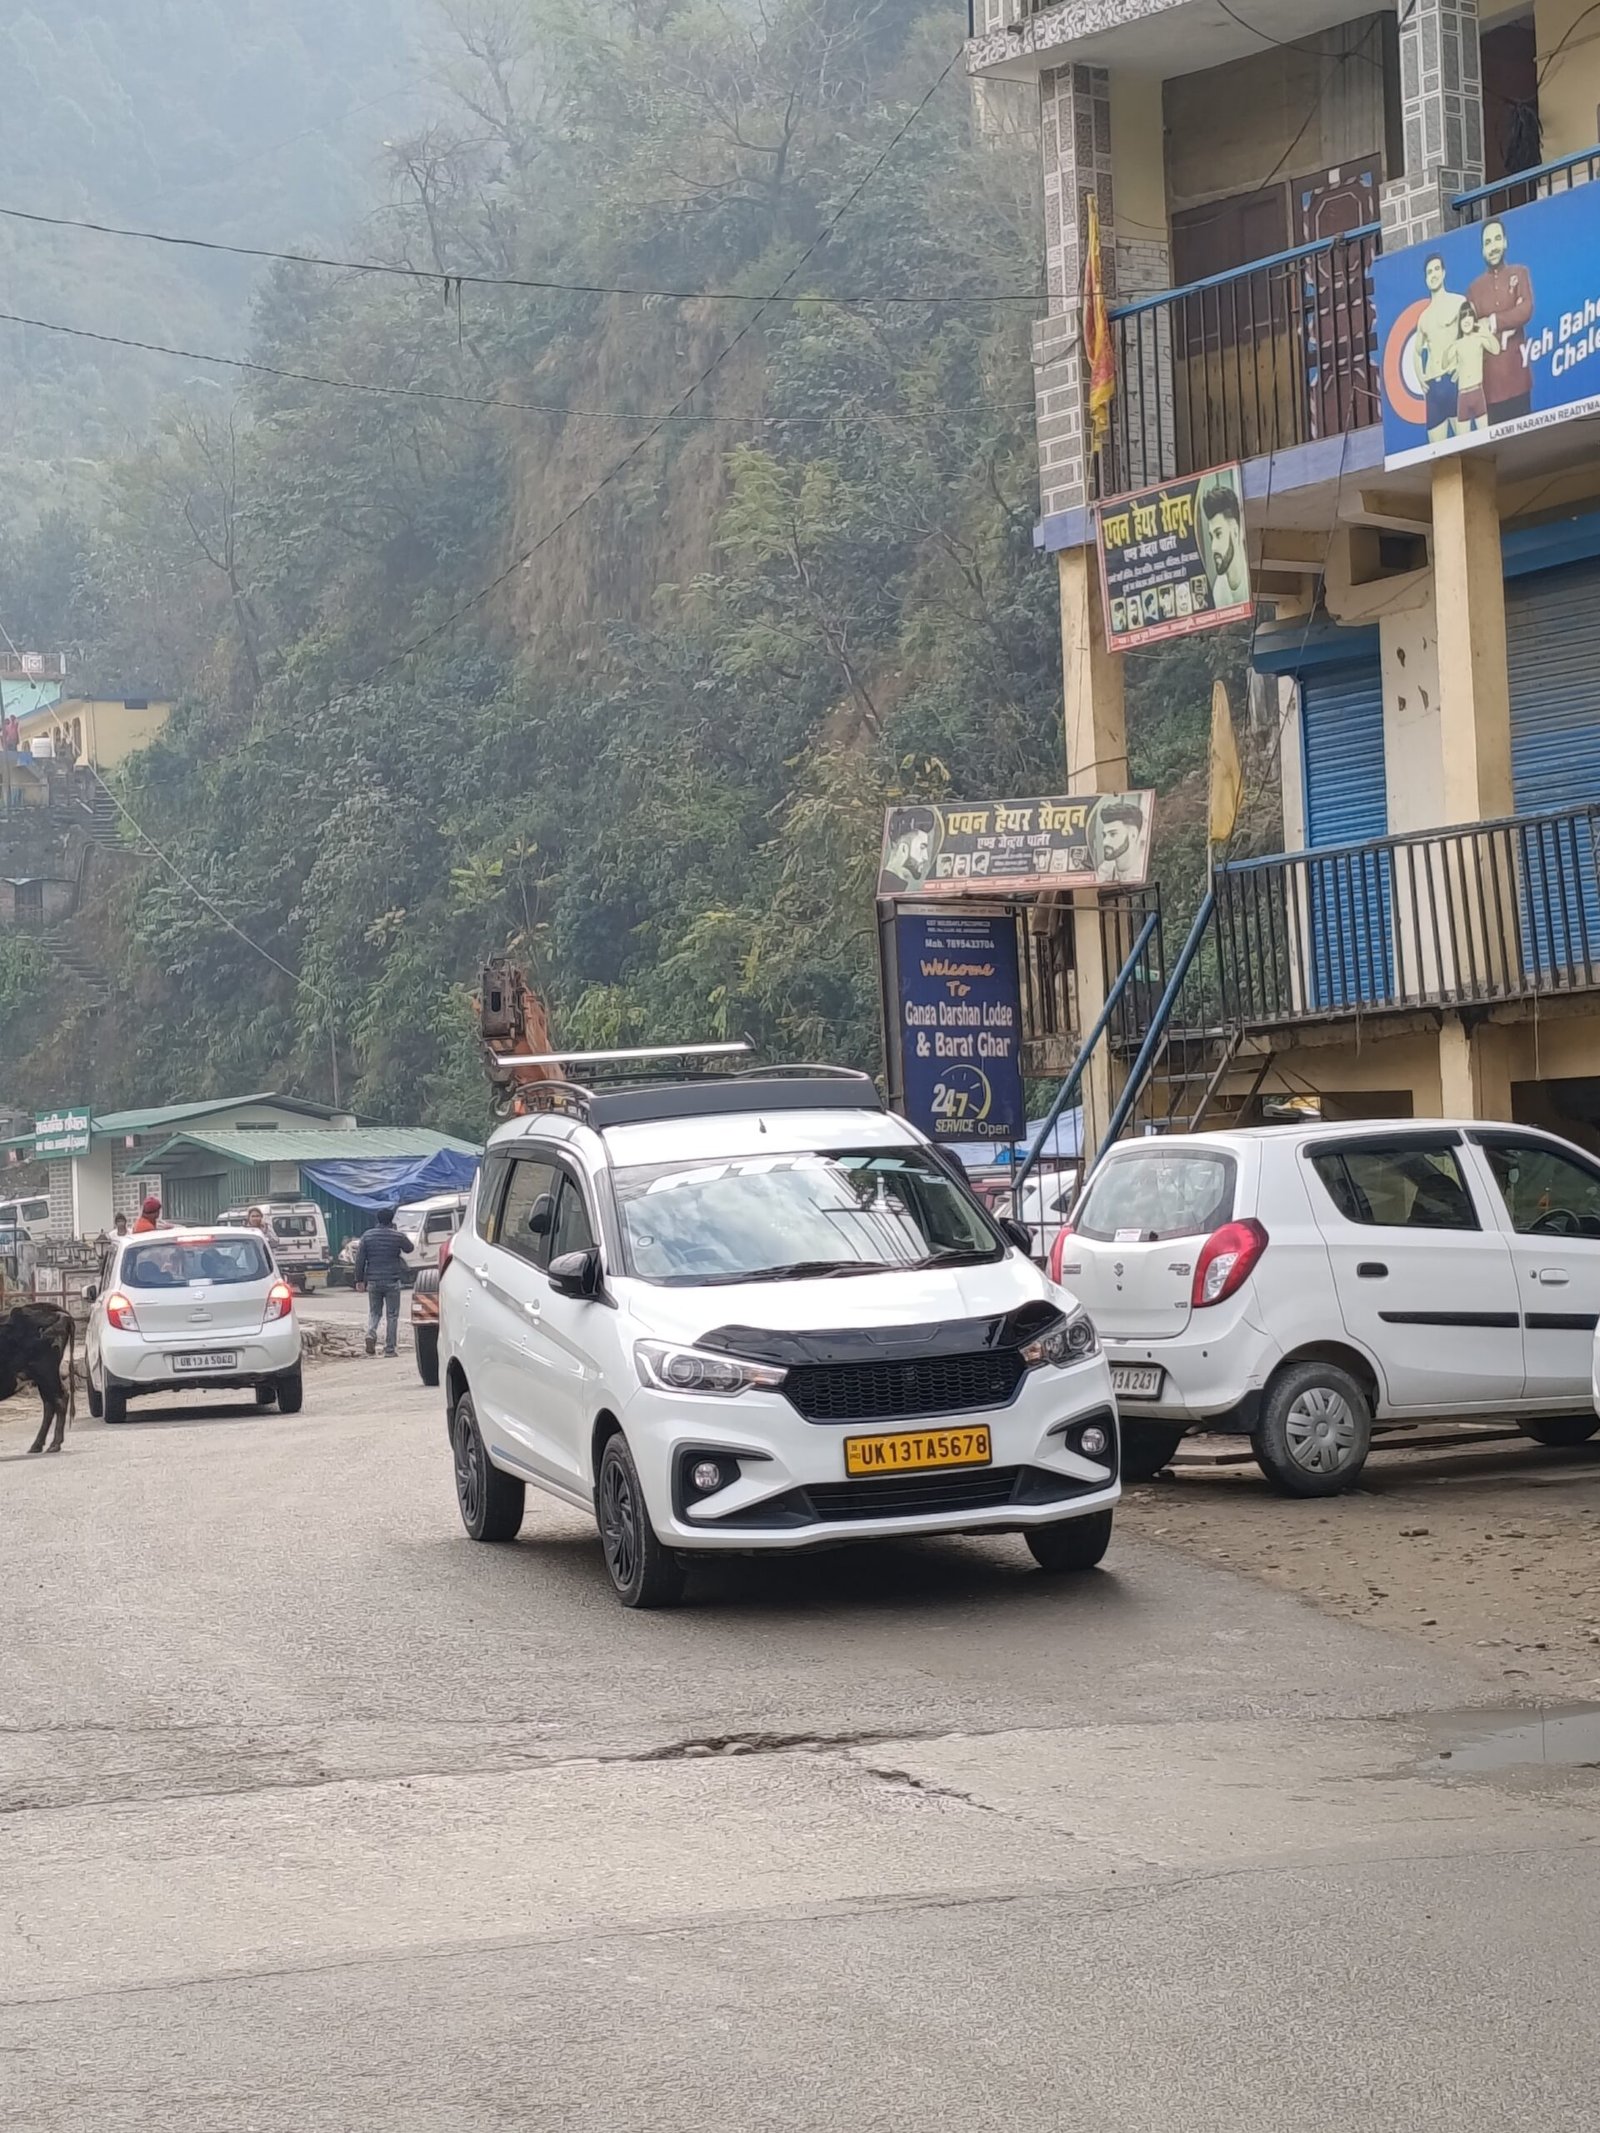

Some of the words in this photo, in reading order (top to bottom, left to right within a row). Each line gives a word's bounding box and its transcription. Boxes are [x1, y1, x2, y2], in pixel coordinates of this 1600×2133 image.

[1520, 327, 1553, 368] Yeh
[1489, 424, 1515, 440] LAXMI
[1516, 412, 1556, 431] NARAYAN
[1102, 513, 1131, 549] एवन
[947, 811, 990, 835] एवन
[994, 804, 1033, 833] हैयर
[1038, 801, 1088, 836] सैलून
[925, 938, 945, 949] Mob.
[920, 957, 995, 977] Welcome
[946, 980, 971, 997] To
[905, 1001, 937, 1026] Ganga
[939, 1001, 981, 1026] Darshan
[983, 1001, 1013, 1026] Lodge
[916, 1031, 931, 1057] &
[935, 1032, 974, 1057] Barat
[977, 1032, 1011, 1057] Ghar
[934, 1118, 976, 1133] SERVICE
[977, 1121, 1010, 1137] Open
[861, 1433, 987, 1466] UK13TA5678
